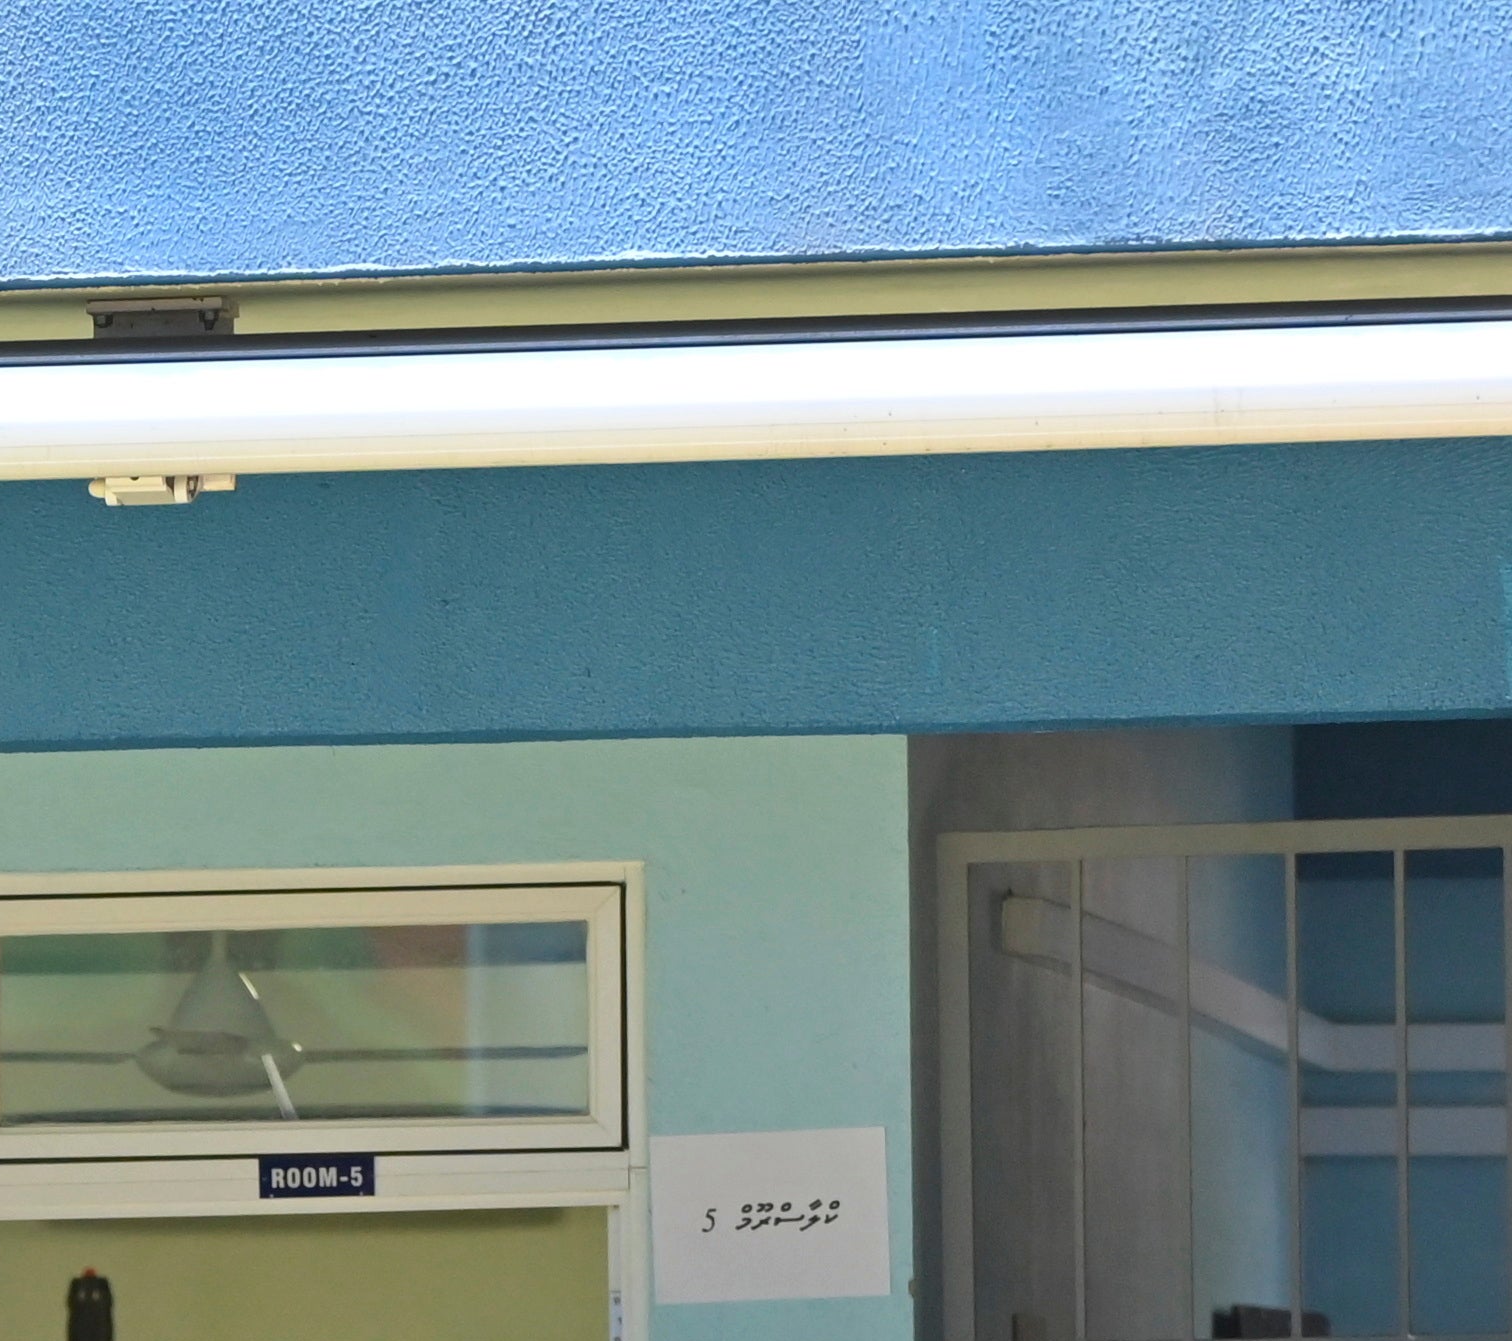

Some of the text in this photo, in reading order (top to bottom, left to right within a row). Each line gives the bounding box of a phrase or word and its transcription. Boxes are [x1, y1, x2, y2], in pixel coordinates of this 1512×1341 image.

[270, 1165, 363, 1189] ROOM-5
[701, 1198, 841, 1233] ކްލާސްރޫމް 5
